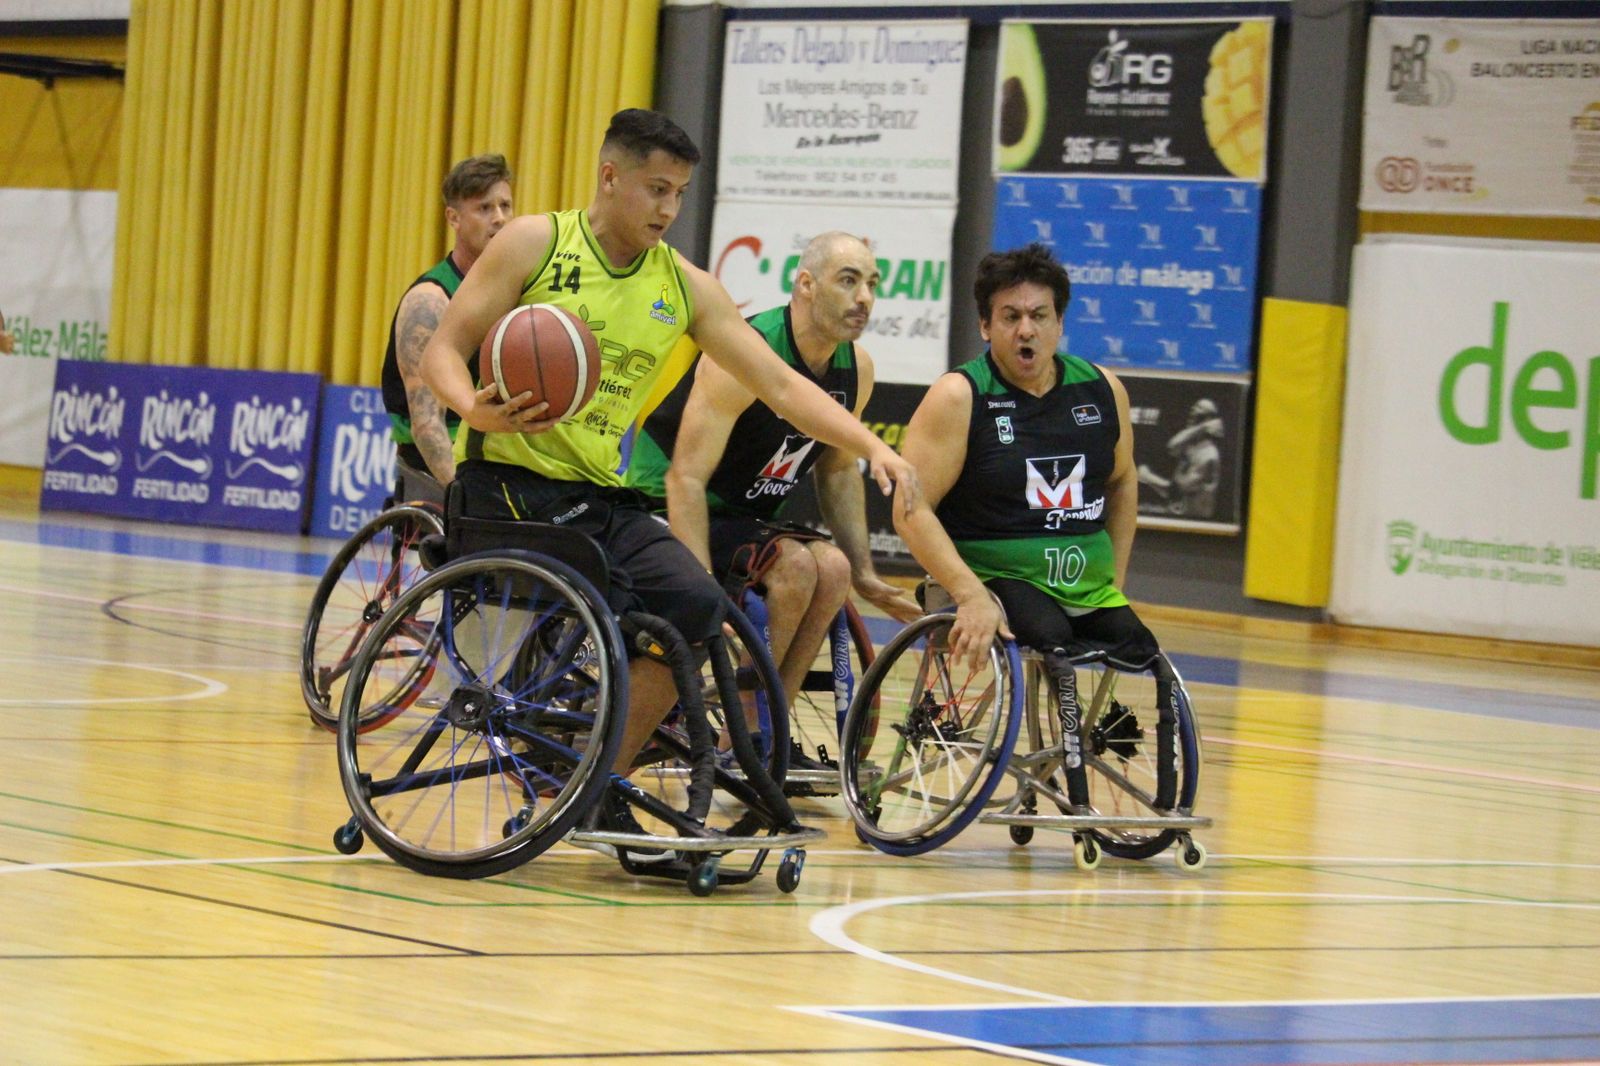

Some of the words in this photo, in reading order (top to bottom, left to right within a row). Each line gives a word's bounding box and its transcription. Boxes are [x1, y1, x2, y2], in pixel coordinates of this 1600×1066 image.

[1470, 62, 1577, 78] BALONCESTO
[763, 102, 919, 130] Mercedes-Benz
[548, 262, 582, 294] 14
[1115, 260, 1138, 286] de
[1141, 261, 1214, 296] málaga
[649, 309, 677, 326] amivel
[44, 470, 119, 496] FERTILIDAD
[132, 477, 210, 504] FERTILIDAD
[223, 484, 301, 511] FERTILIDAD
[1045, 545, 1086, 587] 10
